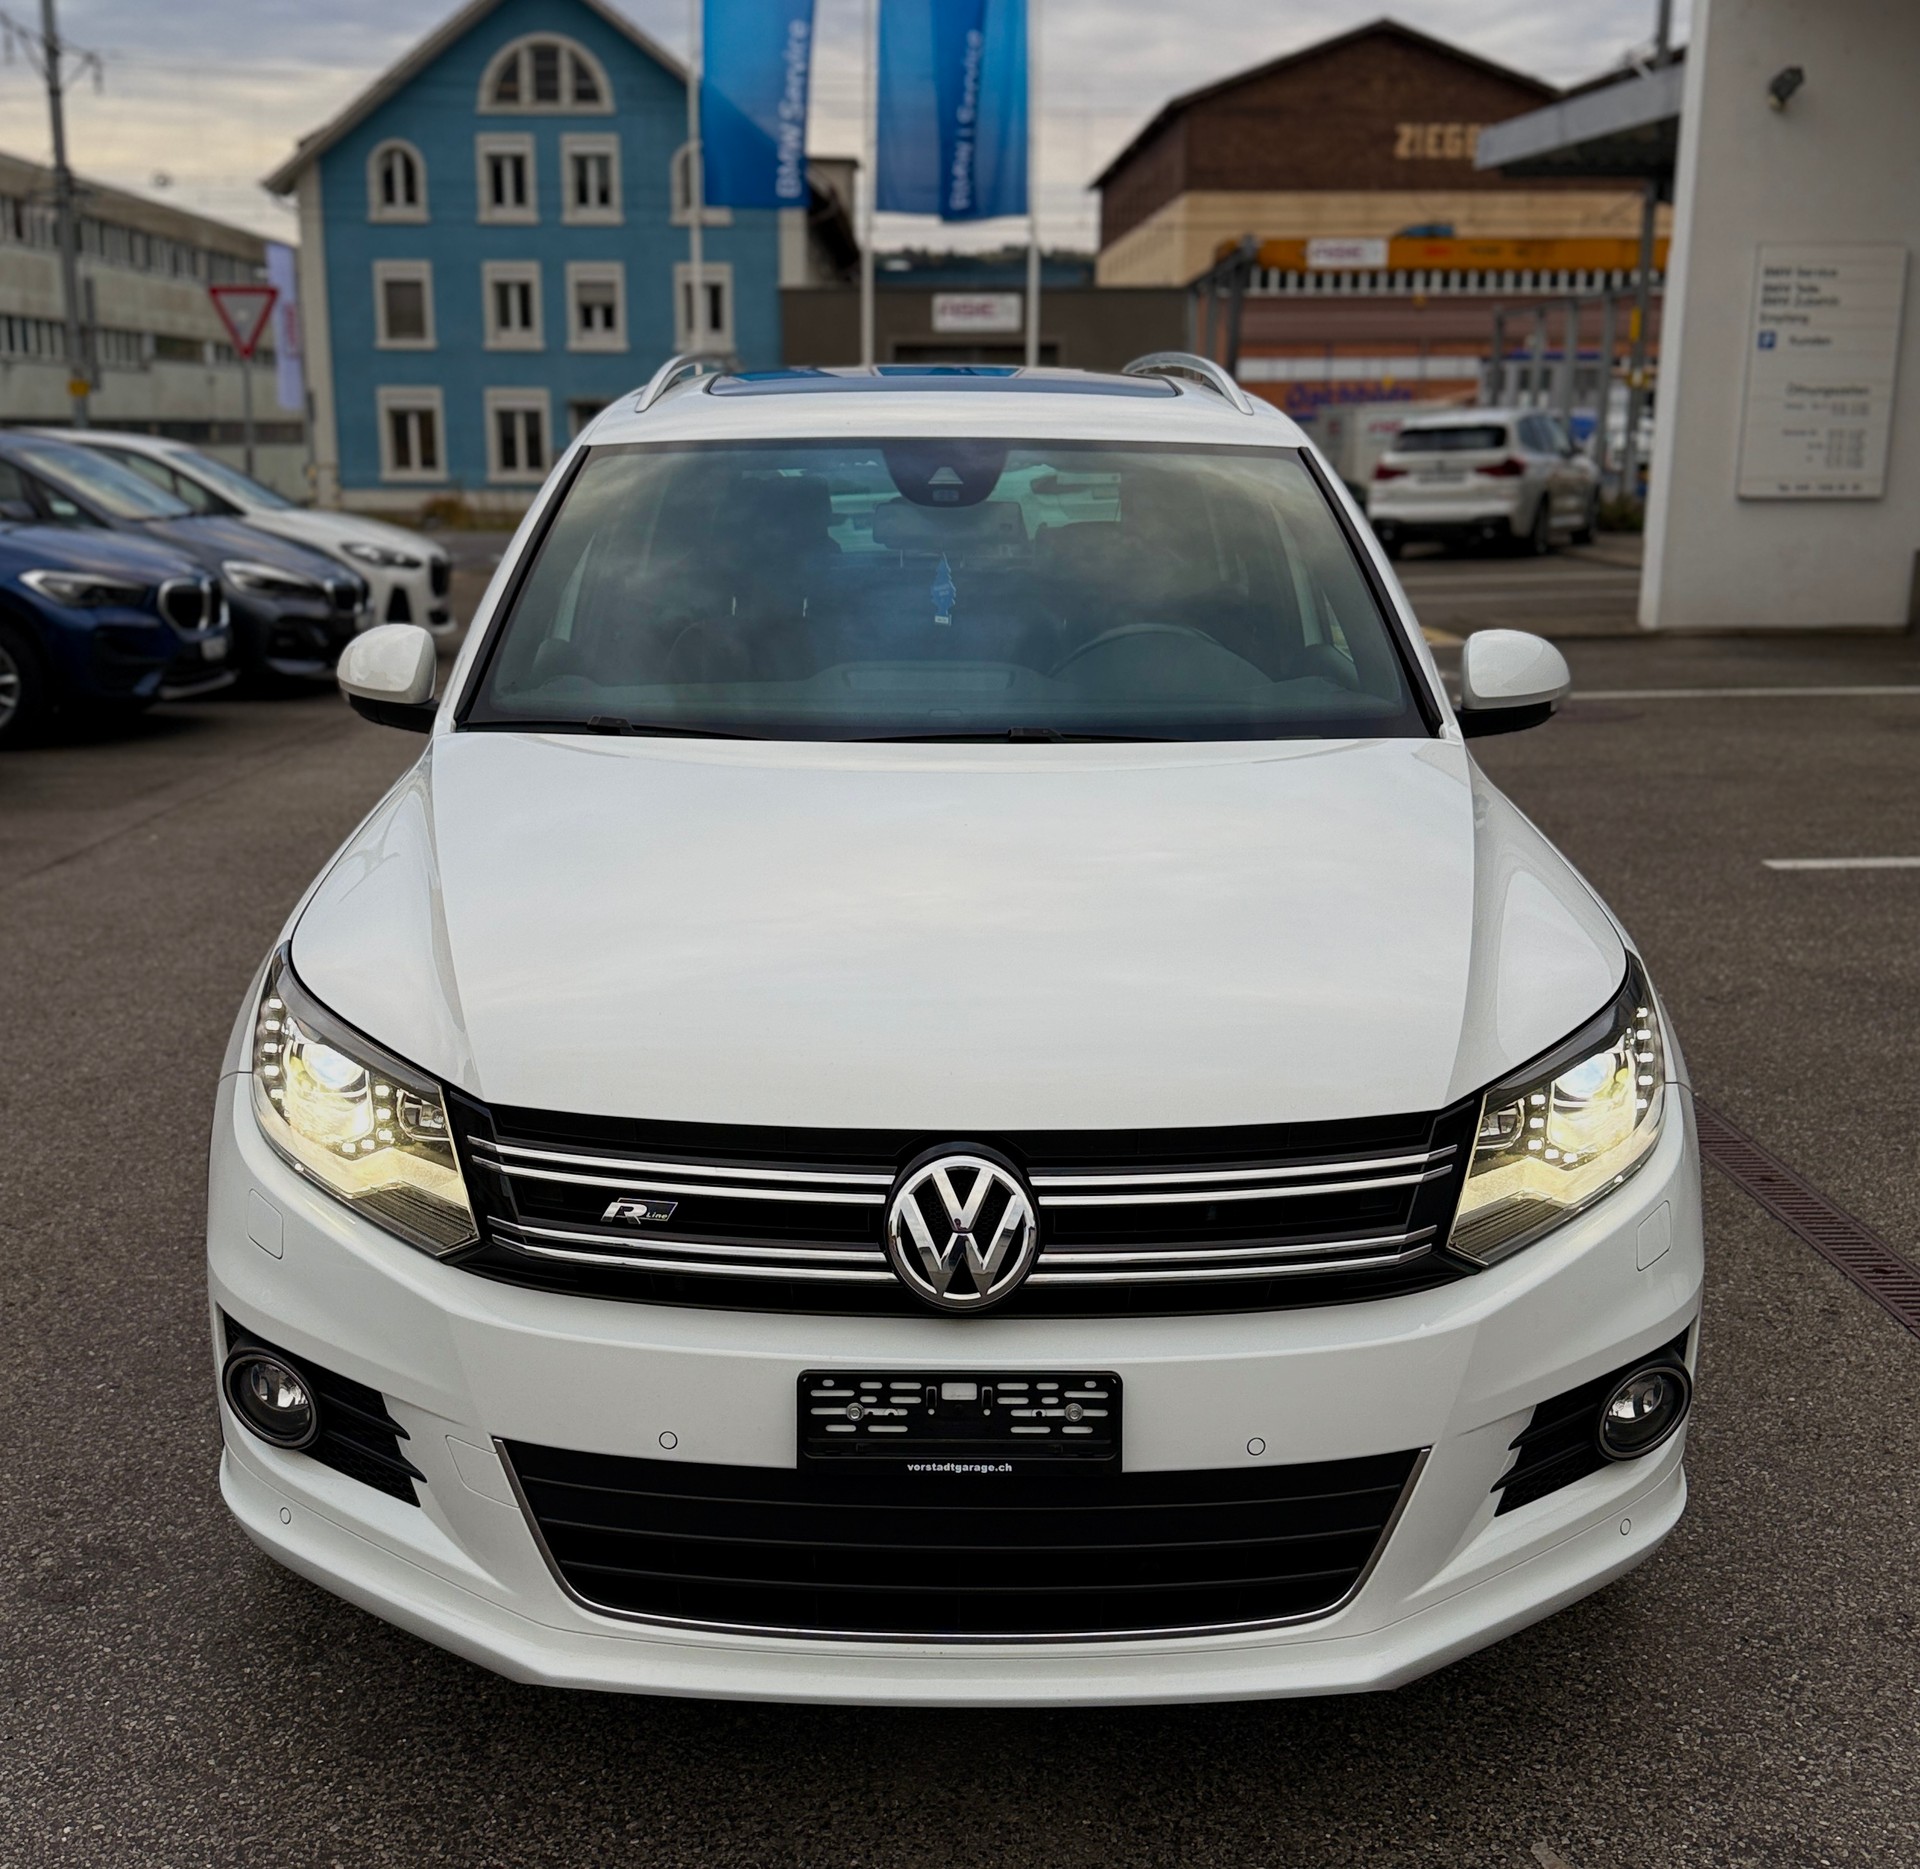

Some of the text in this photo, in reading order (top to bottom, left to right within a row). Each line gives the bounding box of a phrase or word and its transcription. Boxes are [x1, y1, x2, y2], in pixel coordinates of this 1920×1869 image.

[957, 29, 982, 124] Service
[775, 19, 808, 197] BMW Service
[600, 1201, 648, 1225] R
[907, 1463, 1013, 1474] vorstadtgarage.ch
